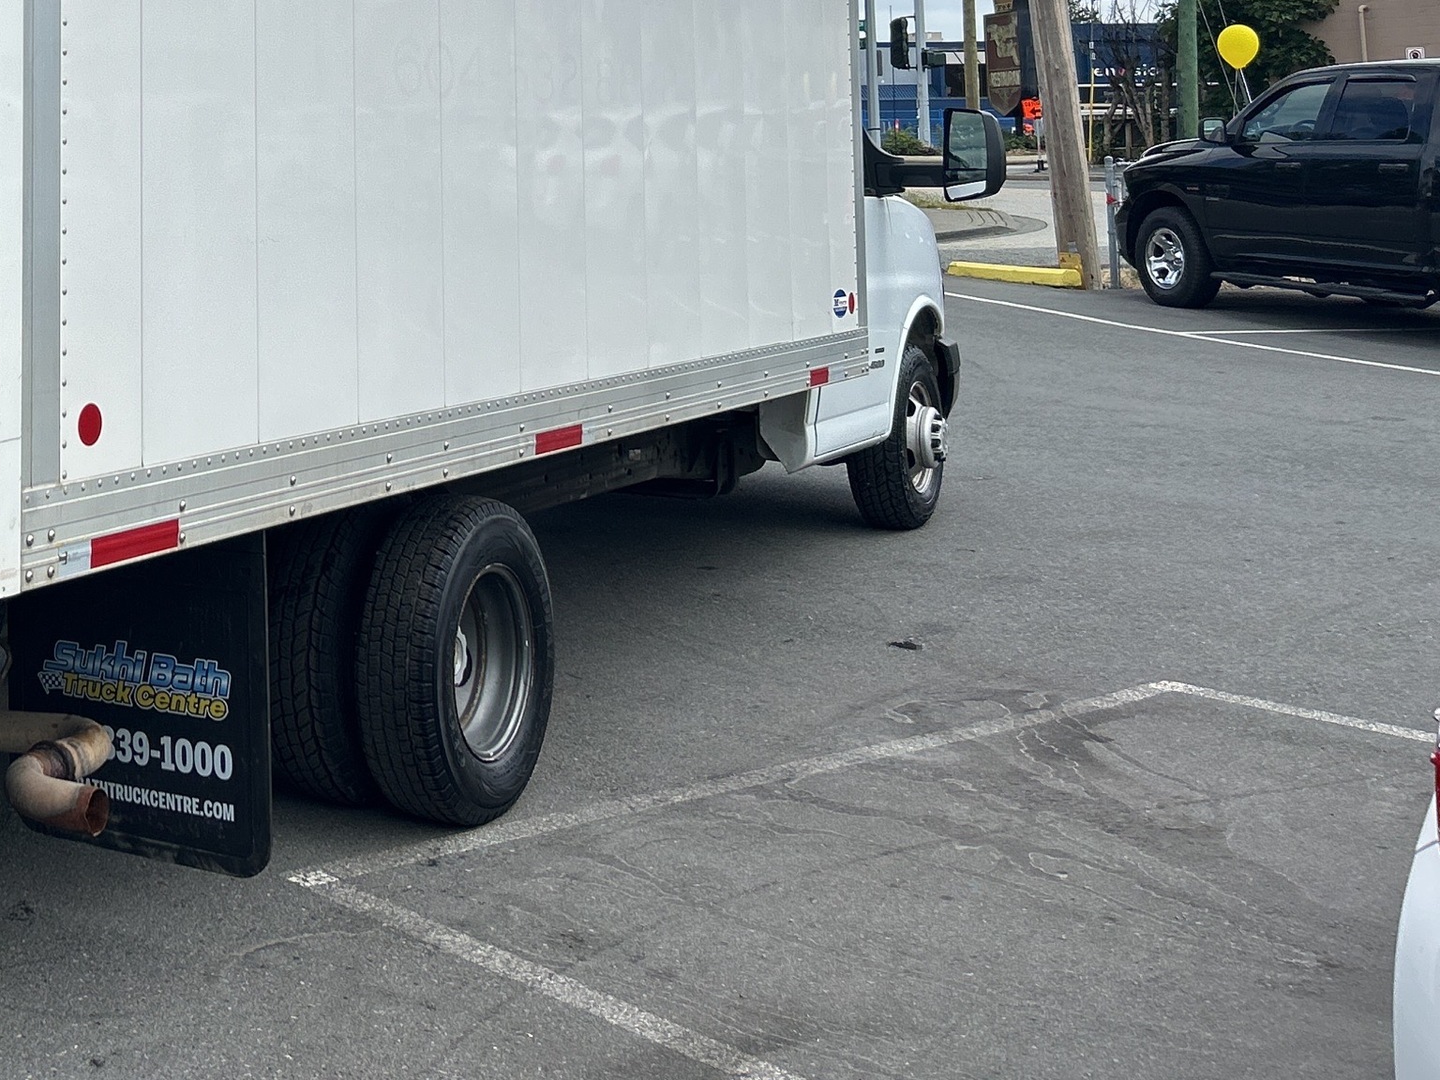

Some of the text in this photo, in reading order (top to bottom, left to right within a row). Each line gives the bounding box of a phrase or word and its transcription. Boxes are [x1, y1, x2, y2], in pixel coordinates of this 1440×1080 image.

[43, 640, 232, 699] Sukhi Bath
[62, 672, 229, 721] Truck Centre
